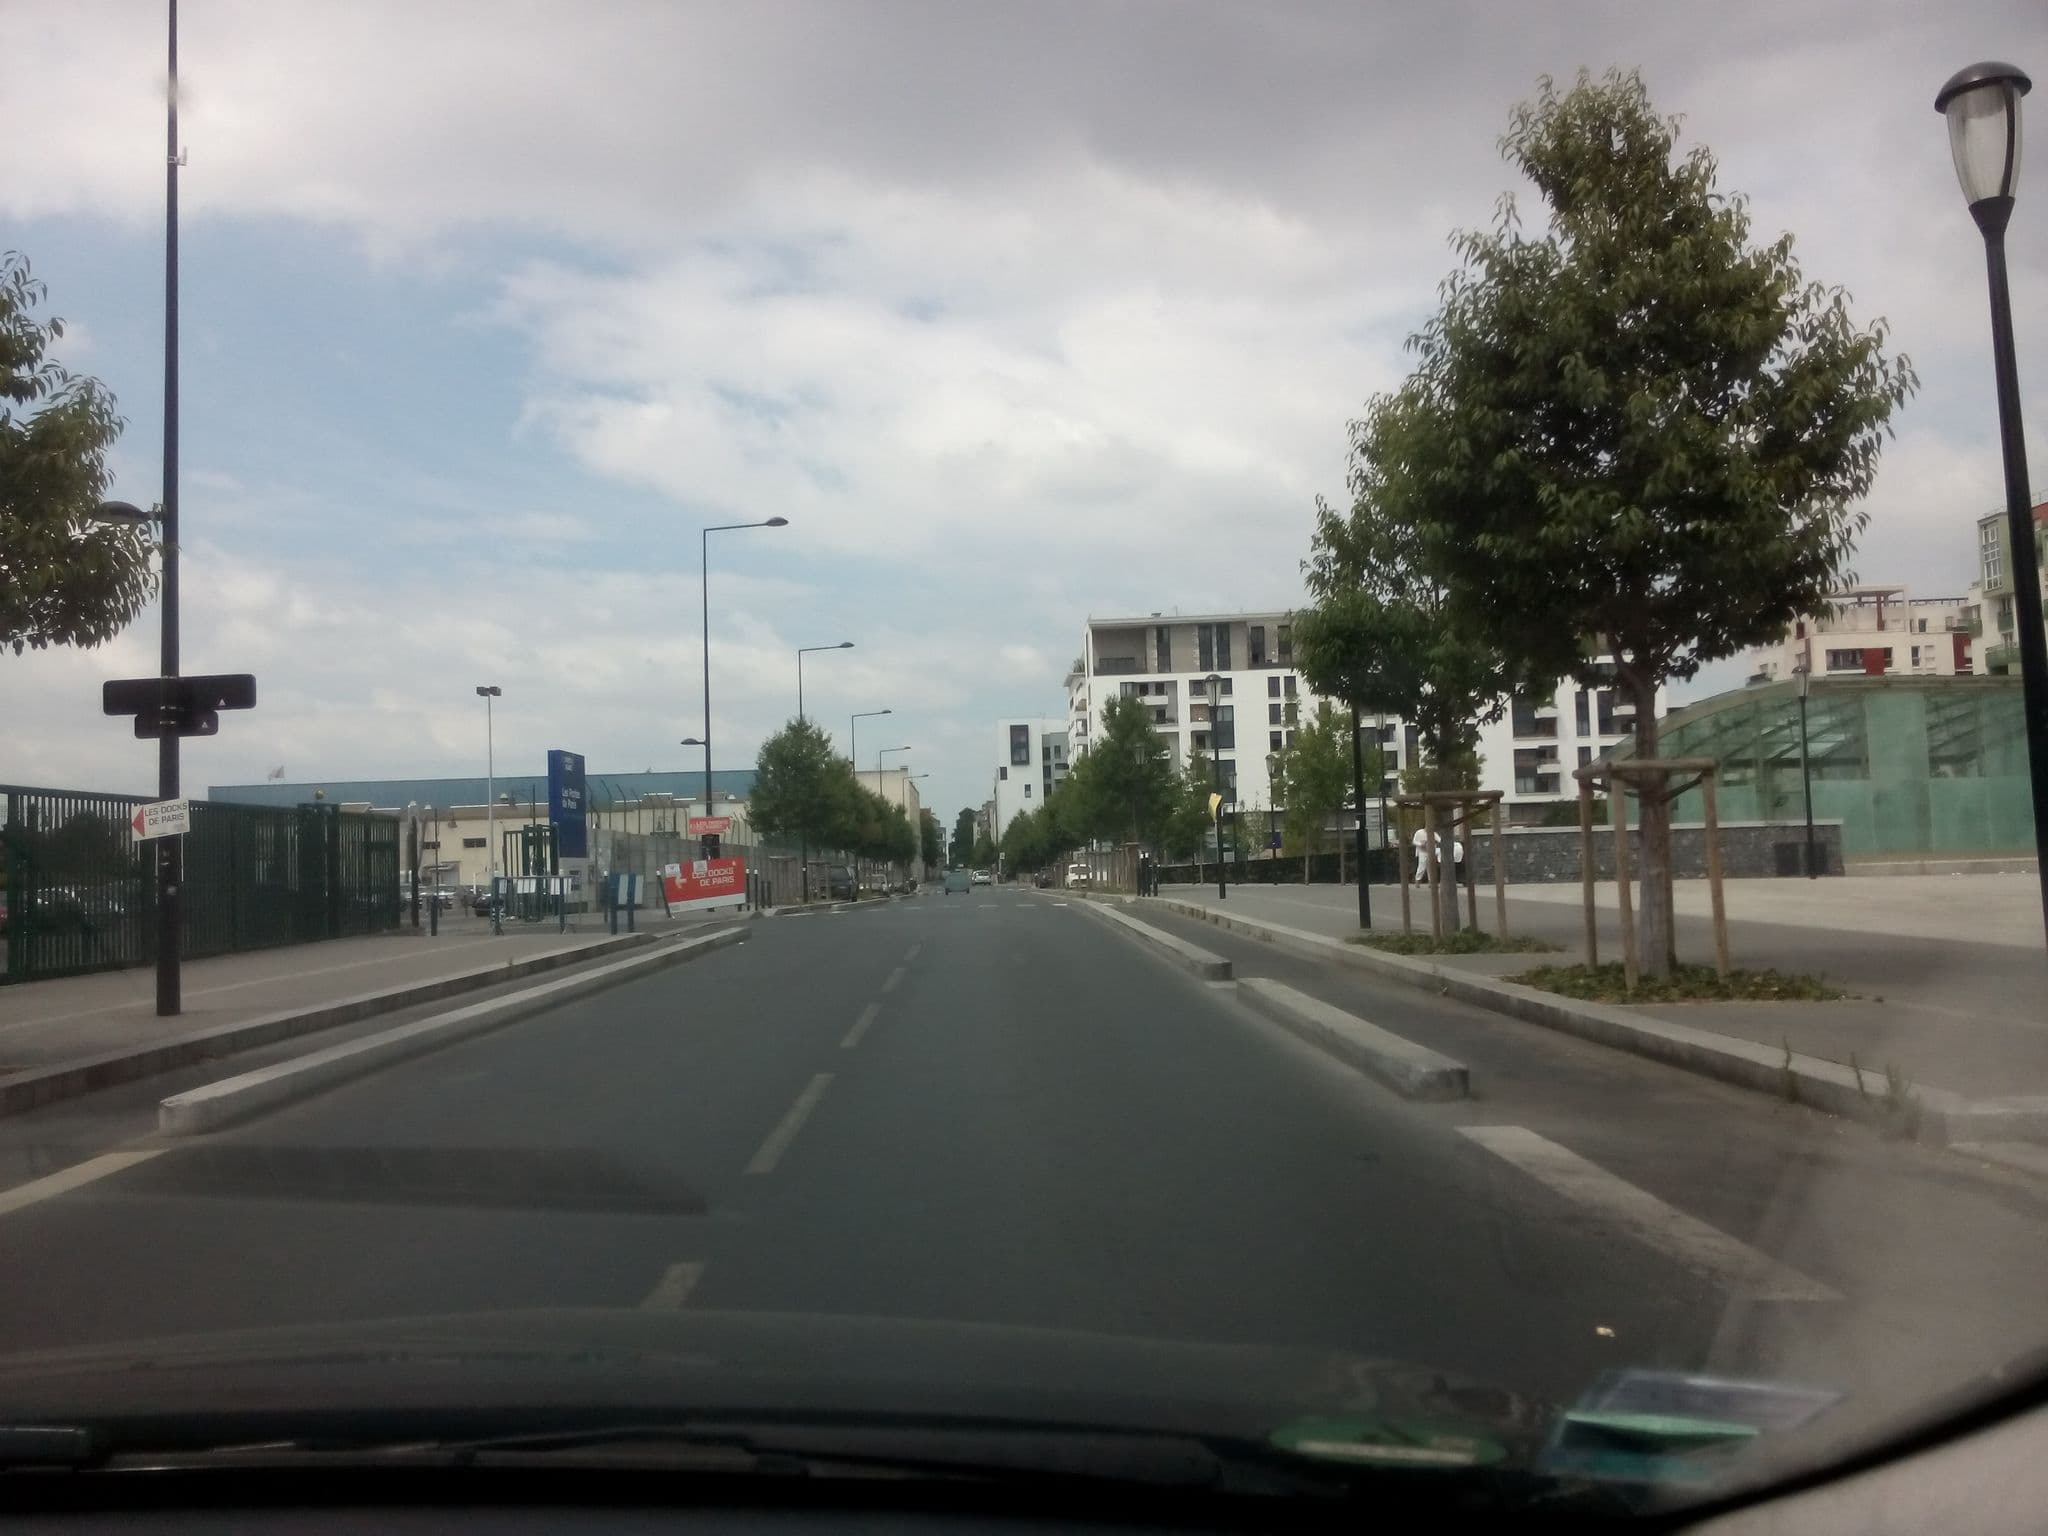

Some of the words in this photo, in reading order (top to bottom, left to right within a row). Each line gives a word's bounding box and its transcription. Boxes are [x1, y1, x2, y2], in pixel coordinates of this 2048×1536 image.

[145, 807, 159, 817] LES
[161, 802, 188, 814] DOCKS
[149, 817, 160, 826] DE
[162, 813, 185, 824] PARIS
[708, 867, 734, 877] DOCKS
[699, 878, 711, 887] DE
[712, 875, 735, 885] PARIS
